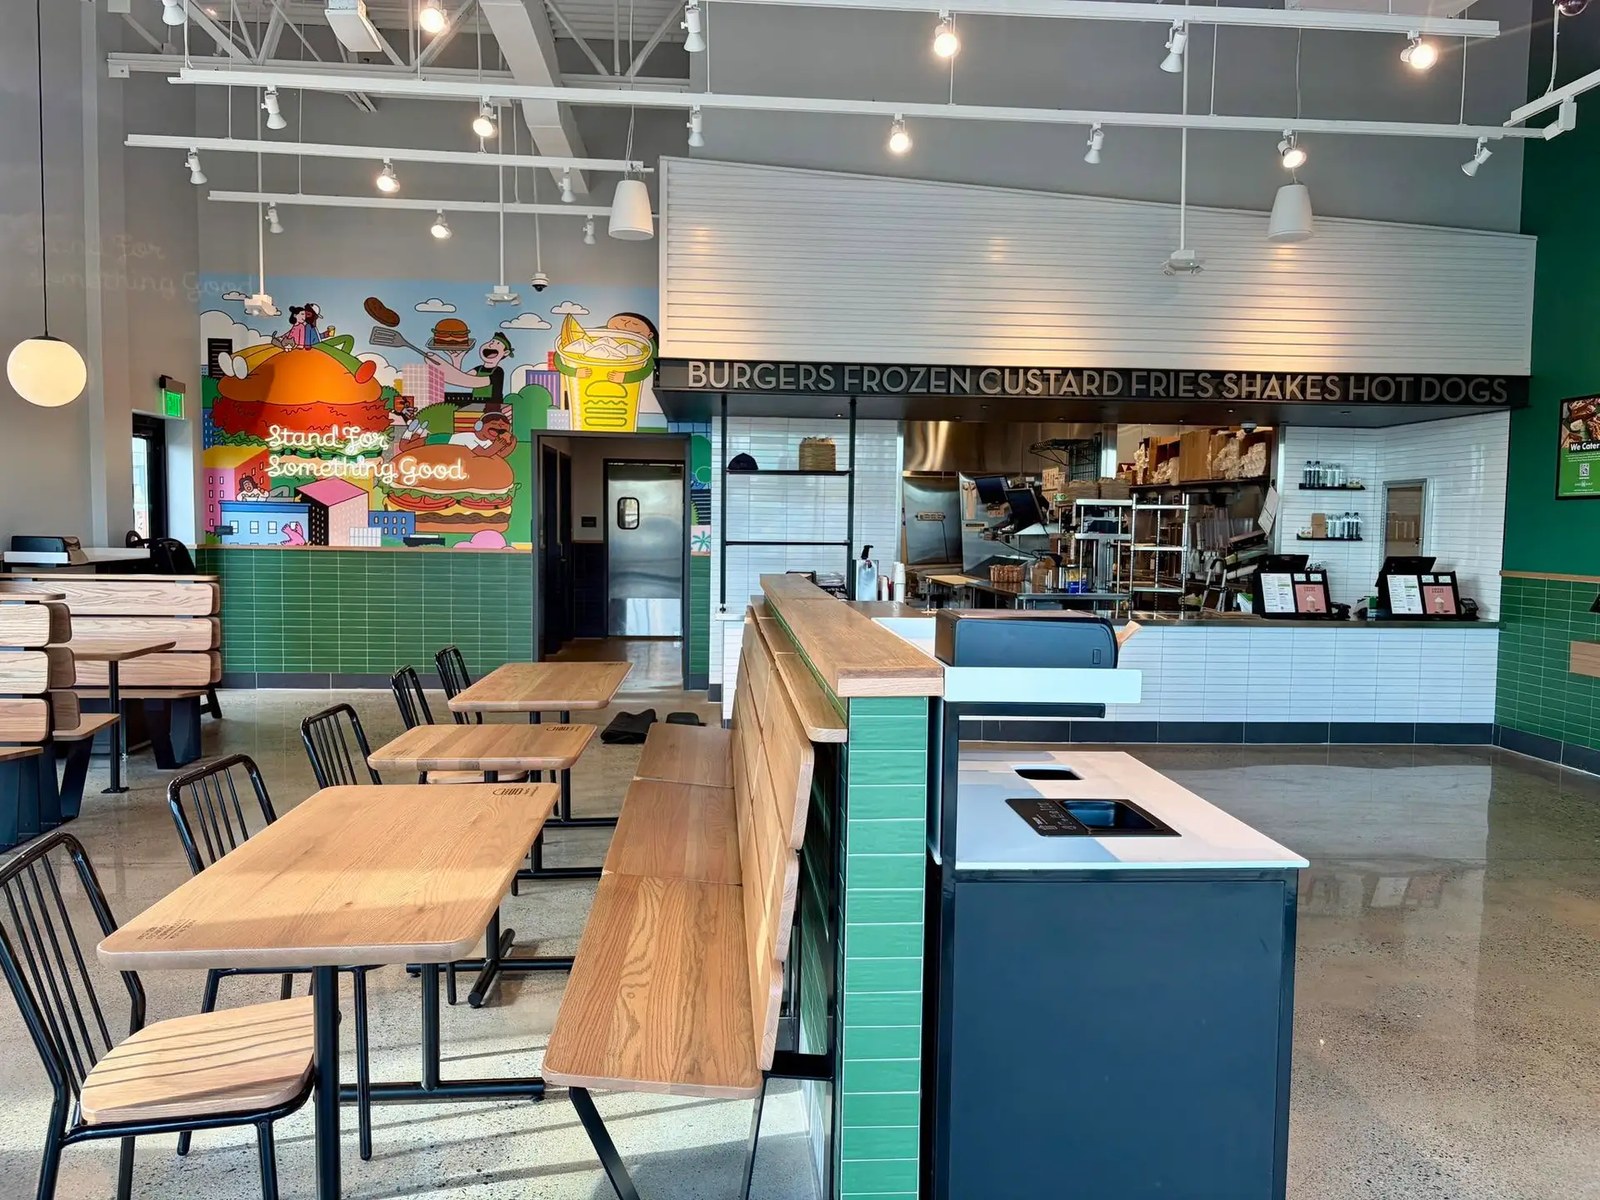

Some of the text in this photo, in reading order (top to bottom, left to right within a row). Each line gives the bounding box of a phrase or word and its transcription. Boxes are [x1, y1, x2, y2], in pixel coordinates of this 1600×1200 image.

[687, 361, 1508, 402] BURGERS FROZEN CUSTARD FRIES SHAKES HOT DOGS
[265, 424, 389, 455] Stand For
[1570, 443, 1581, 451] We
[264, 455, 468, 485] Something Good
